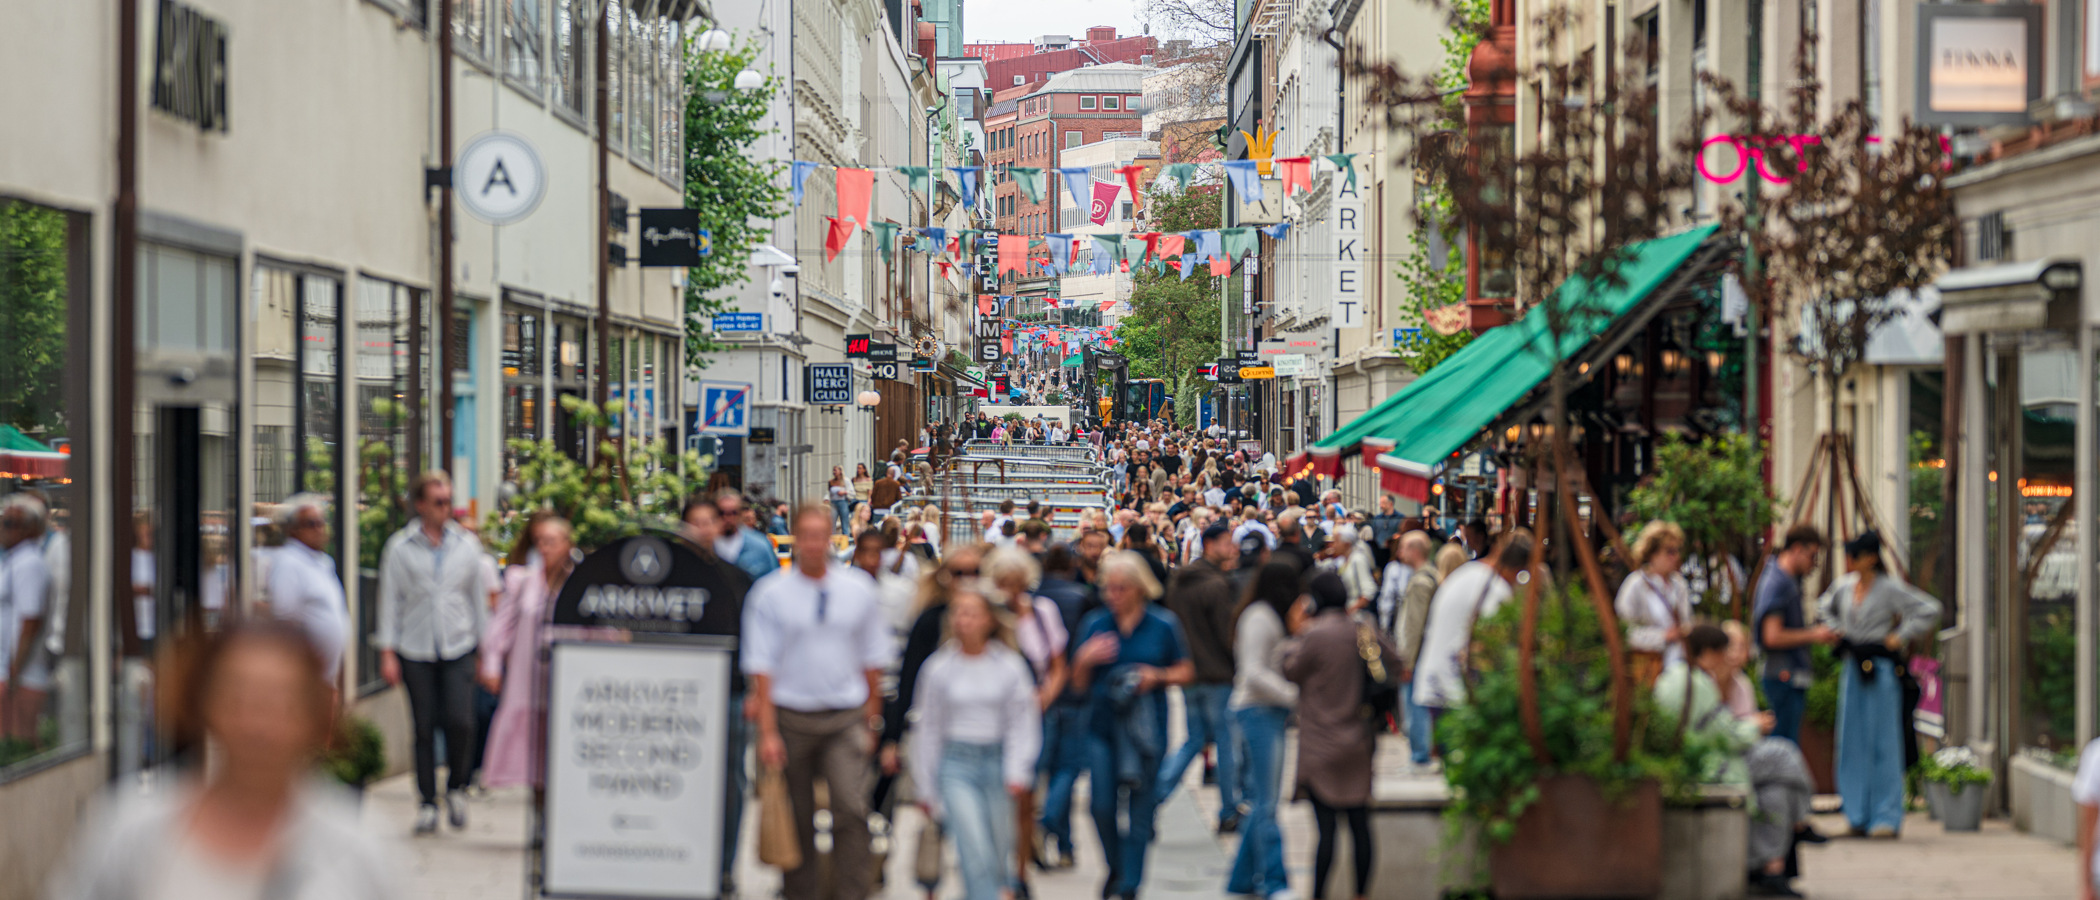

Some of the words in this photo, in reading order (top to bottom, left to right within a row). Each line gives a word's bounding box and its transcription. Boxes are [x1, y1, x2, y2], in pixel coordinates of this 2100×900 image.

[482, 157, 517, 196] A
[1338, 176, 1358, 324] ARKET
[848, 338, 869, 354] H&M
[815, 368, 847, 379] HALL
[871, 364, 896, 379] MQ
[815, 379, 847, 389] BERG
[814, 390, 849, 401] GULD
